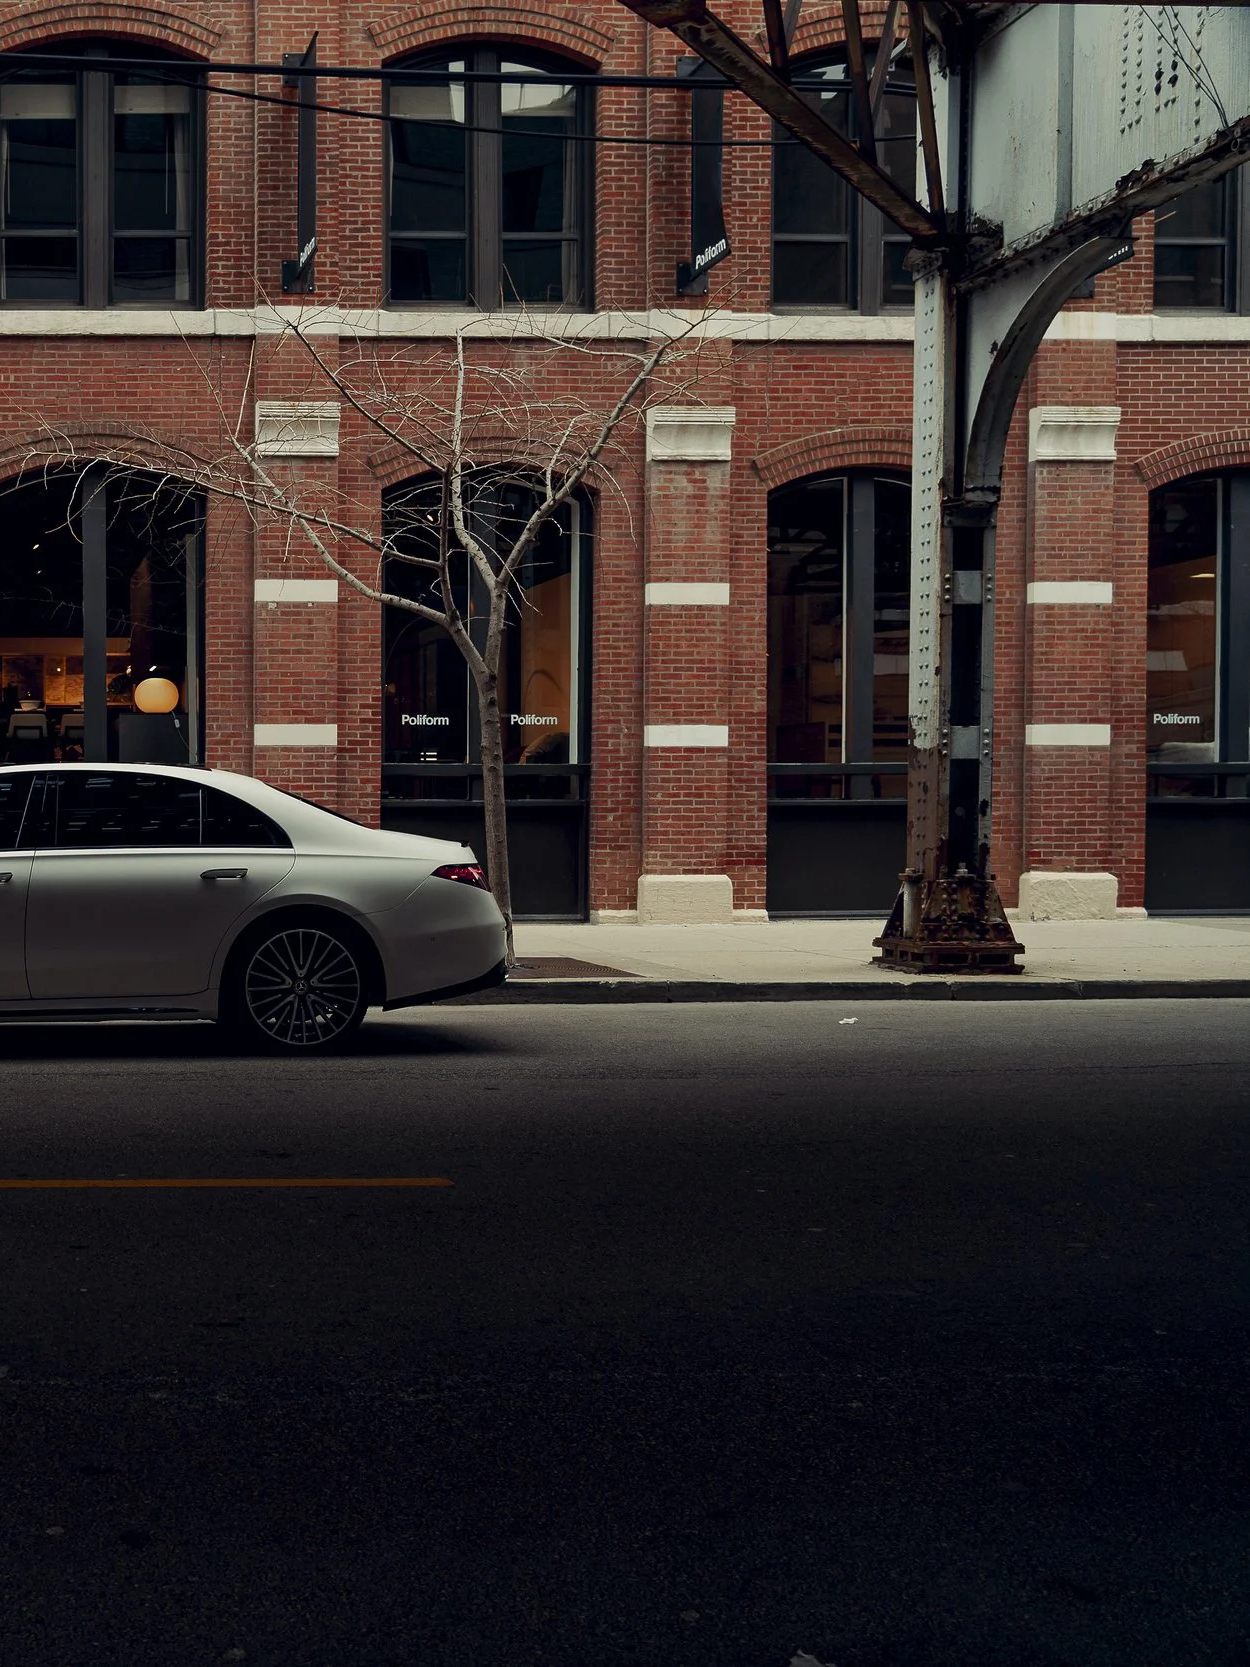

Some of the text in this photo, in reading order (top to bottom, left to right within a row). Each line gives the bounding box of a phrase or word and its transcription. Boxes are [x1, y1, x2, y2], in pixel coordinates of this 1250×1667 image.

[695, 239, 726, 270] Poliform
[401, 714, 449, 725] Poliform
[510, 714, 558, 725] Poliform
[1153, 713, 1200, 724] Poliform
